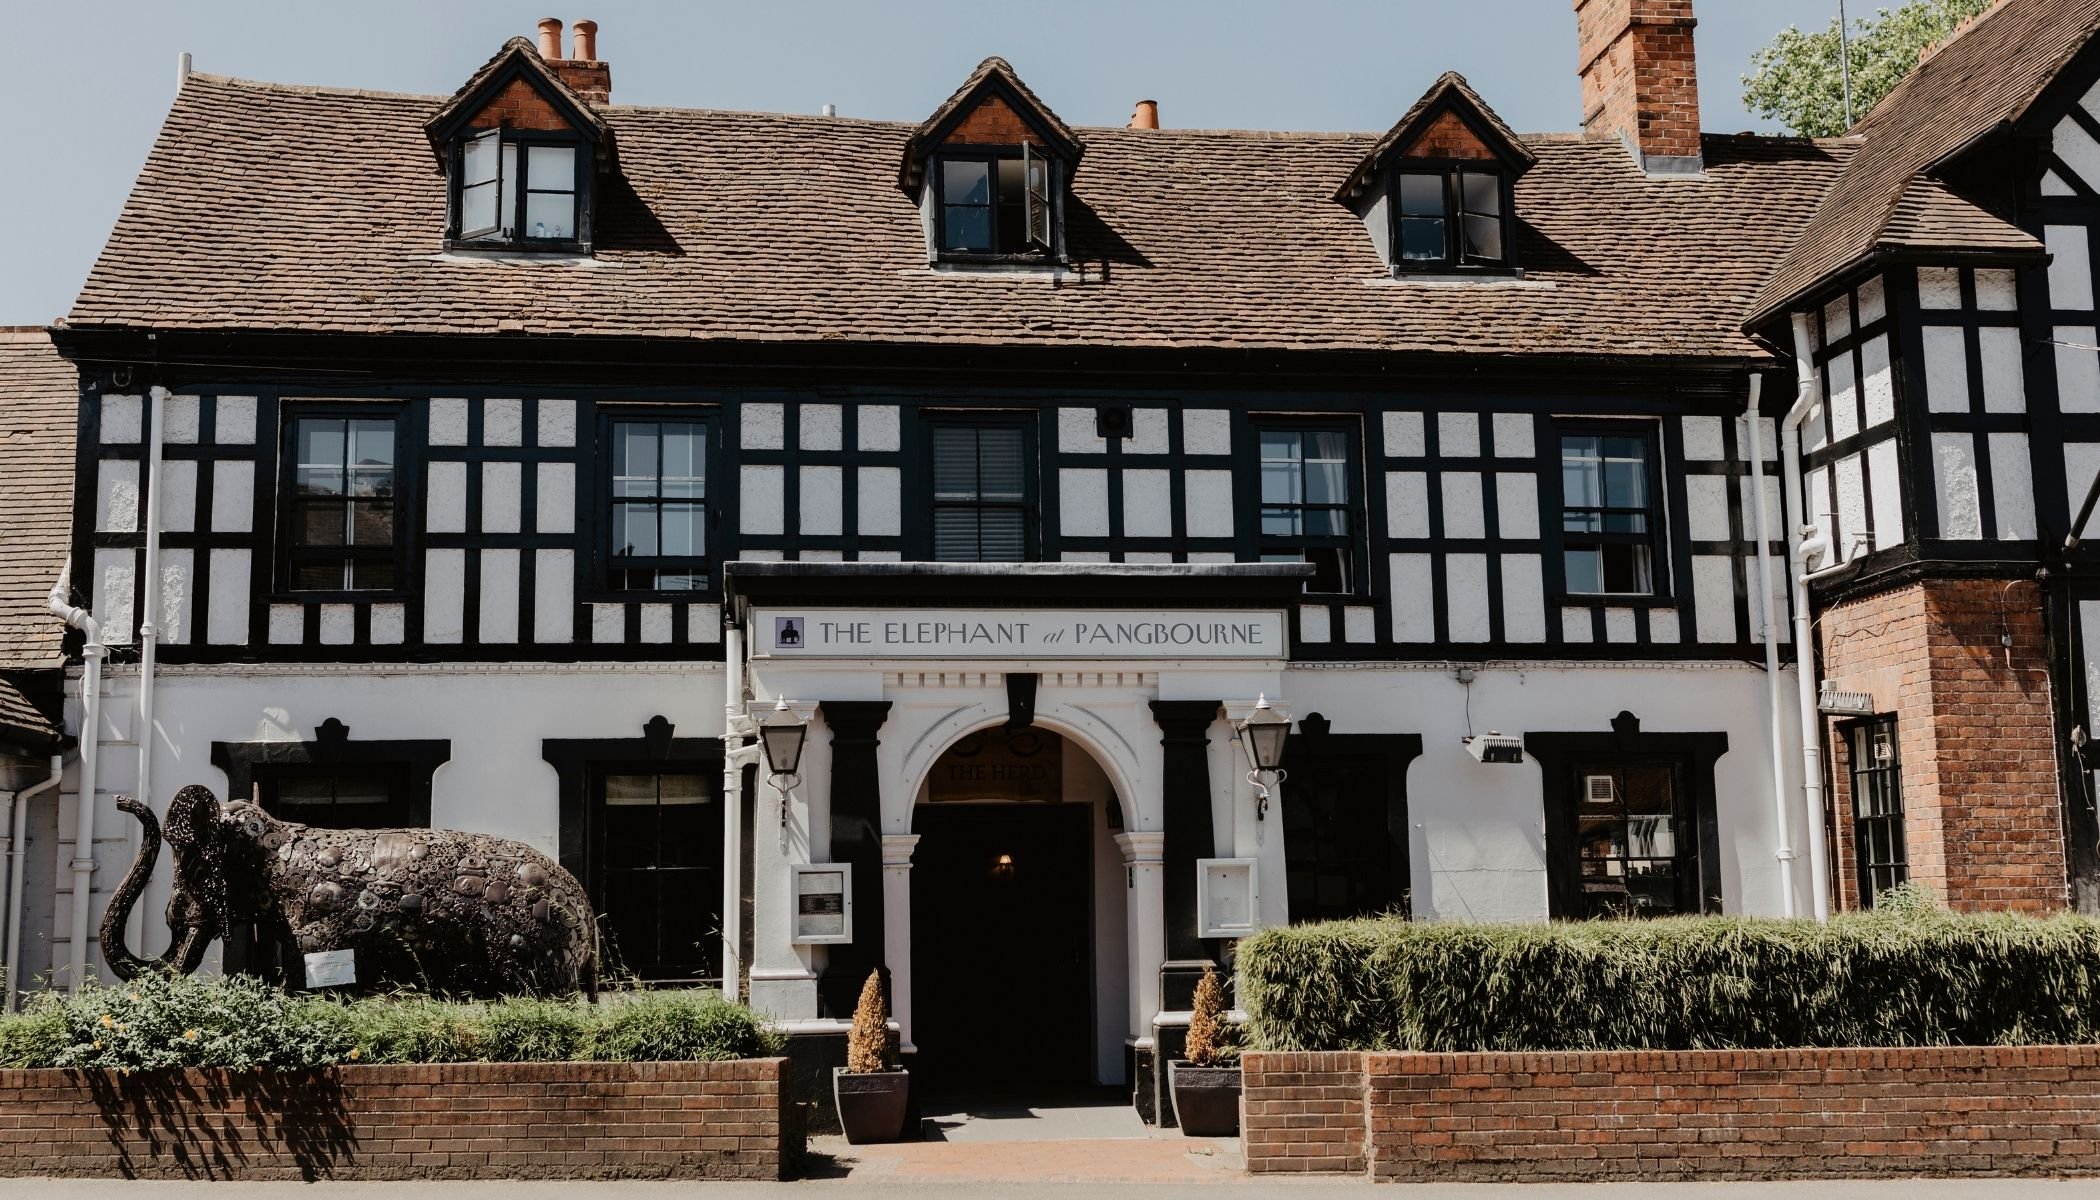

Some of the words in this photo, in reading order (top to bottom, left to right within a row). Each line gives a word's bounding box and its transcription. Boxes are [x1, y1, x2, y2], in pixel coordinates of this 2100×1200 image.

[819, 622, 872, 644] THE
[884, 622, 1030, 644] ELEPHANT
[1075, 622, 1263, 645] PANGBOURNE
[947, 764, 986, 781] THE
[992, 764, 1046, 781] HERD
